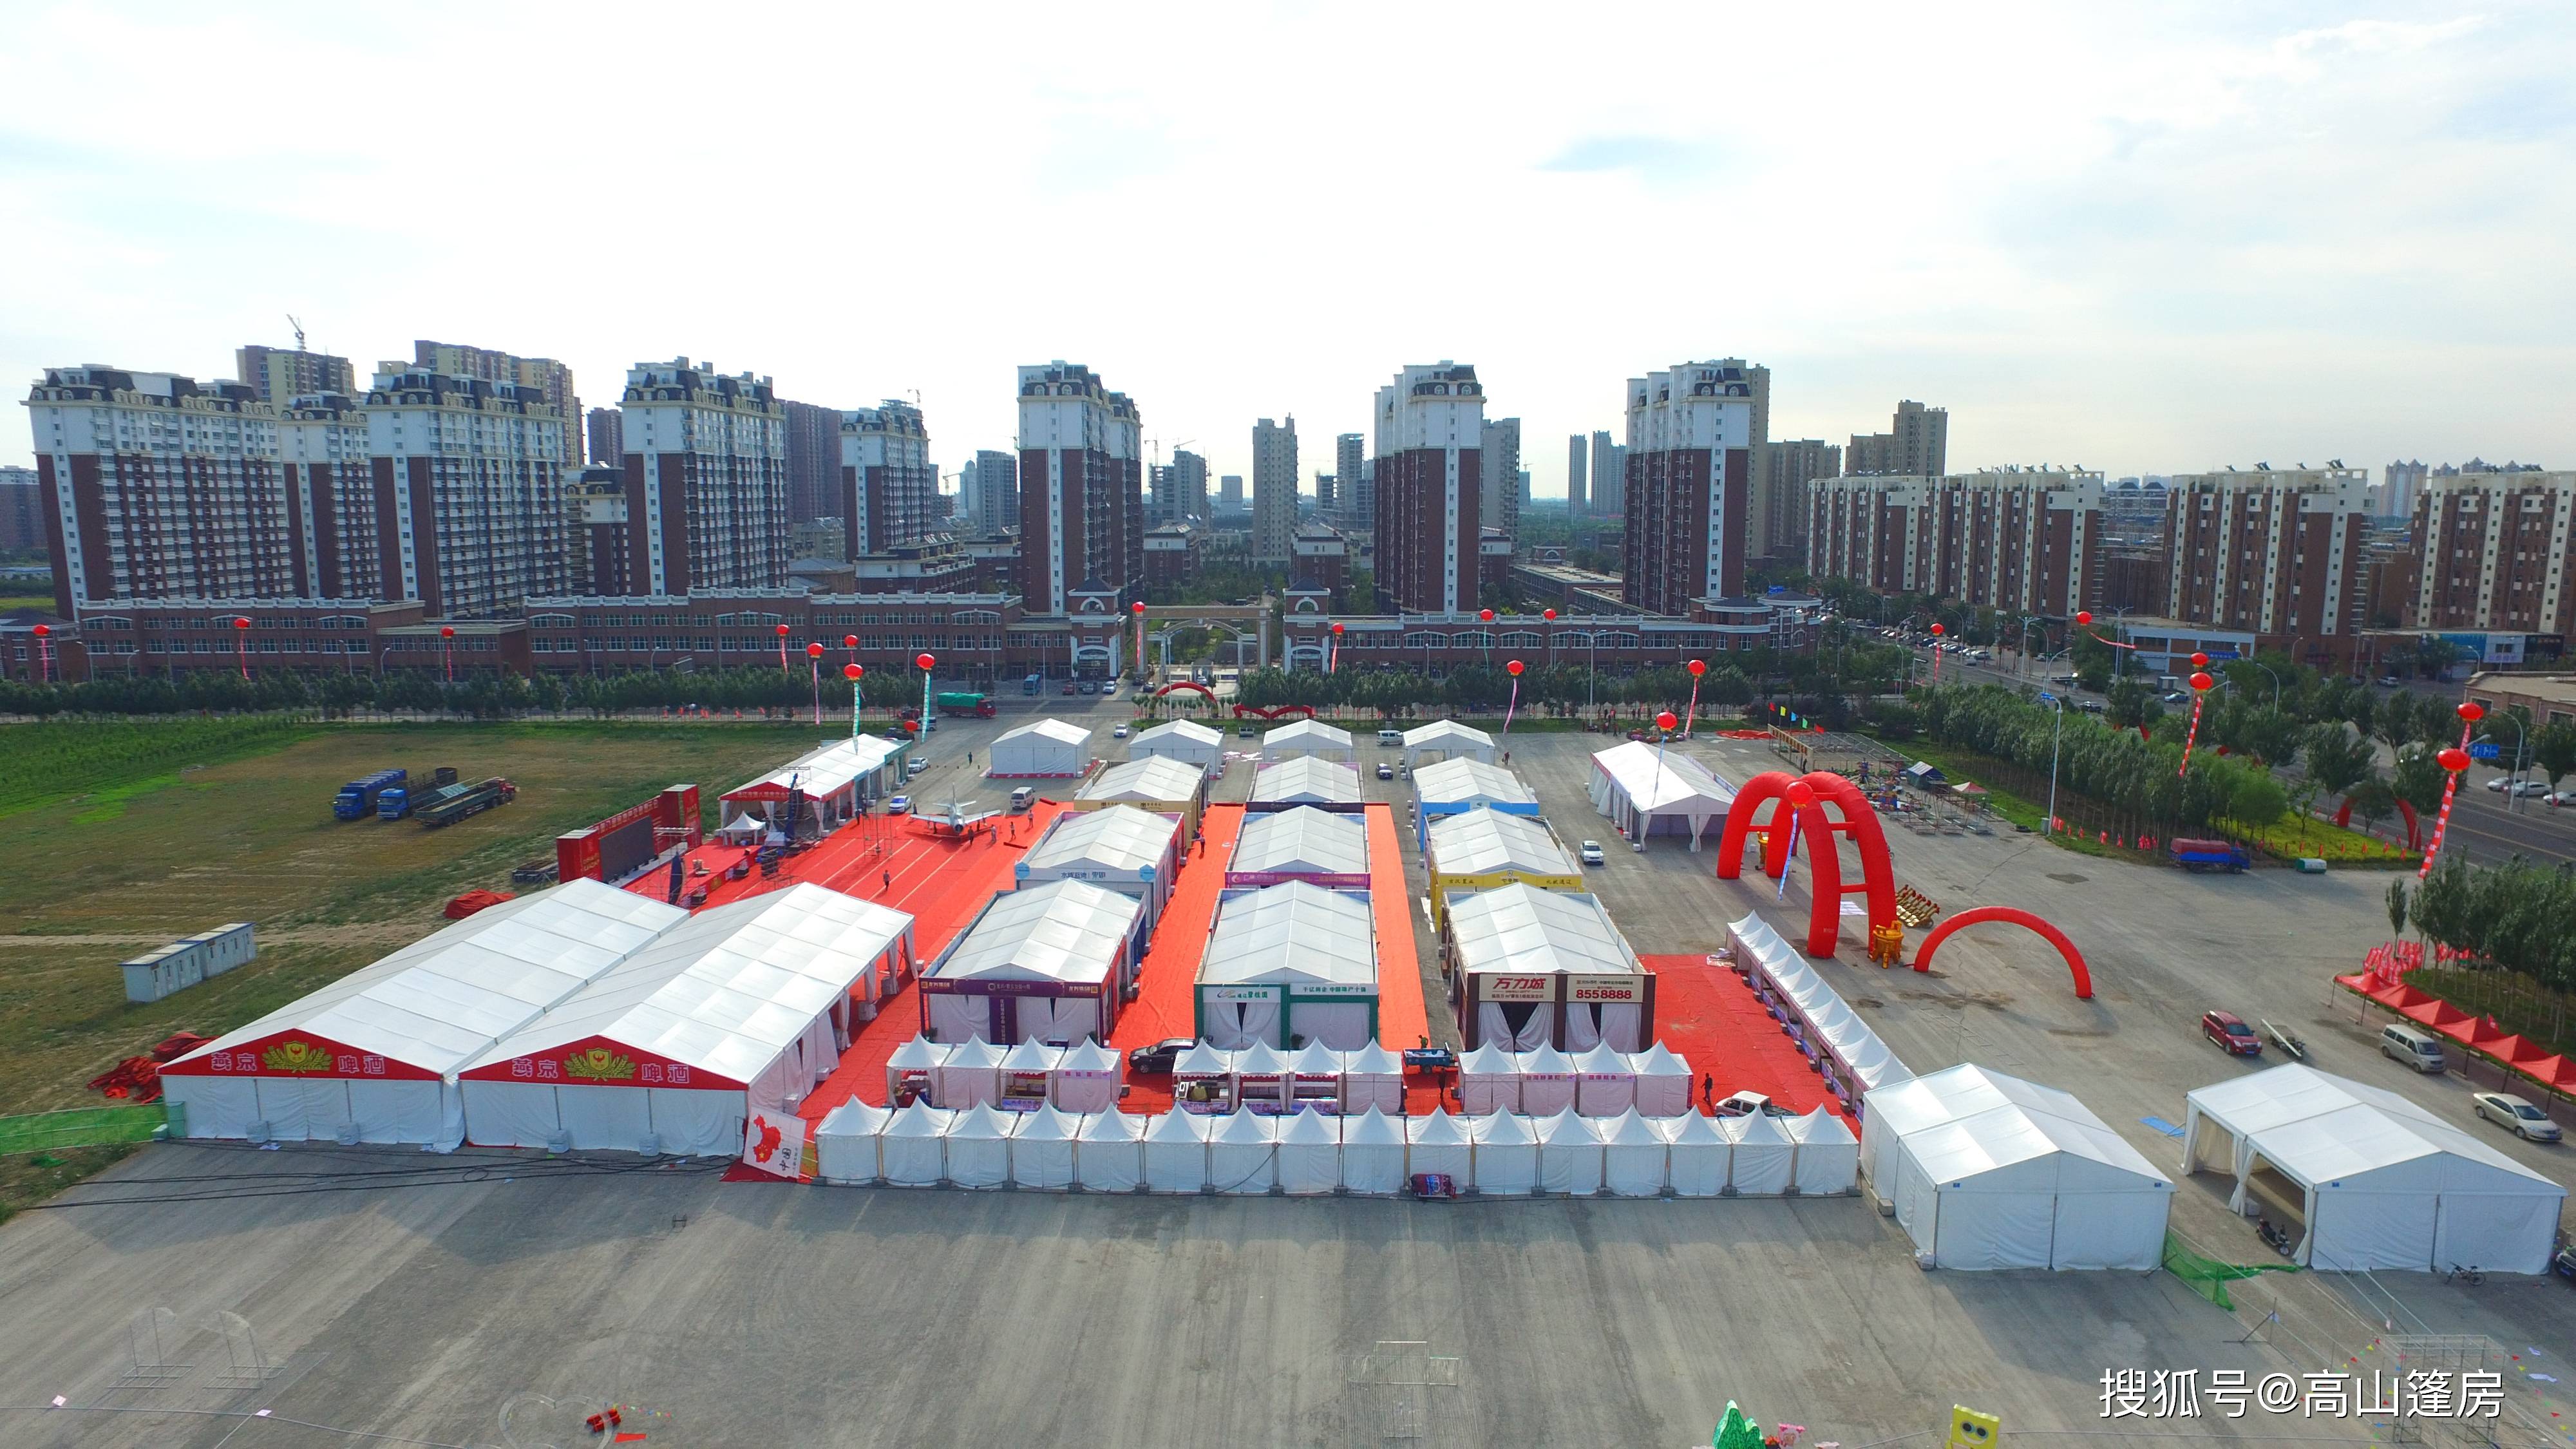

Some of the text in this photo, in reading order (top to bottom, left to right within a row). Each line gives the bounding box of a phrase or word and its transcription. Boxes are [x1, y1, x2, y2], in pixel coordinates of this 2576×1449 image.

[1492, 978, 1546, 989] 万力城
[1576, 989, 1632, 999] 8558888
[211, 1052, 386, 1074] 燕京 啤酒
[511, 1057, 690, 1084] 燕京 啤酒
